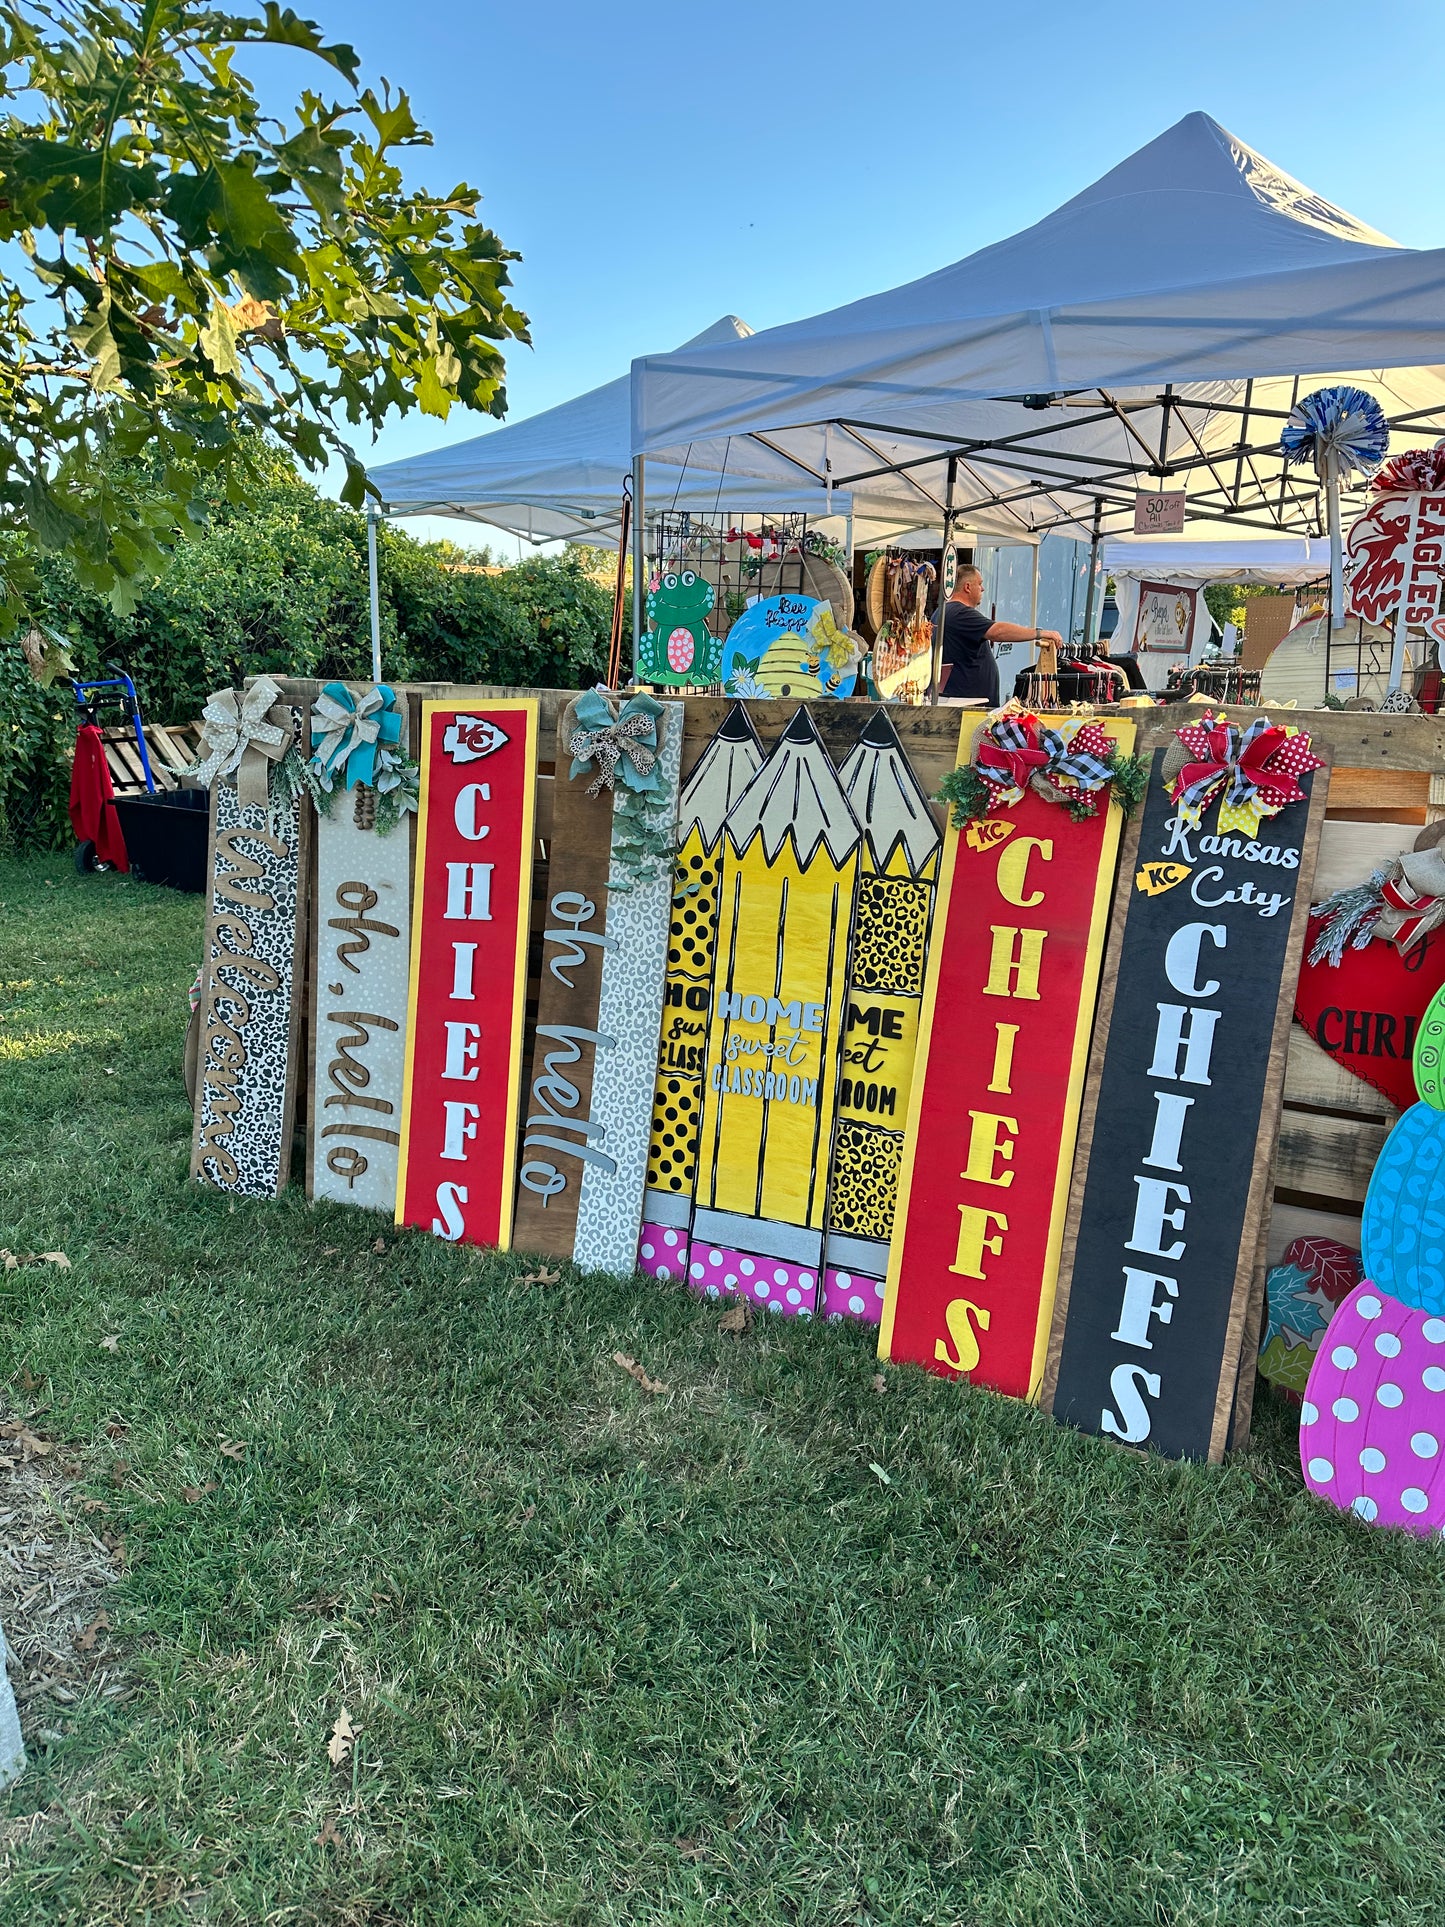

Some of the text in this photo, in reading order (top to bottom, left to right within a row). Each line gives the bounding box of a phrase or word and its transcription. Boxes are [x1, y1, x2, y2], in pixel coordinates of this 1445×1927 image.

[1405, 496, 1445, 624] EAGLES
[765, 609, 809, 632] Happ
[778, 596, 808, 615] Bee
[457, 724, 494, 753] KC
[977, 822, 1005, 844] KC
[1161, 816, 1300, 869] Kansas
[1149, 865, 1179, 888] KC
[1190, 865, 1292, 918] City
[432, 783, 495, 1242] CHIEFS
[664, 982, 709, 1011] HO
[718, 991, 825, 1032] HOME
[668, 1017, 706, 1040] sw
[847, 1003, 905, 1040] ME
[1317, 1006, 1418, 1060] CHRI
[520, 891, 620, 1209] oh hello
[725, 1031, 811, 1066] sweet
[844, 1038, 889, 1073] eet
[320, 1011, 400, 1190] hello
[711, 1063, 819, 1107] CLASSROOM
[840, 1078, 897, 1116] ROOM
[934, 836, 1053, 1372] CHIEFS
[1101, 922, 1227, 1443] CHIEFS
